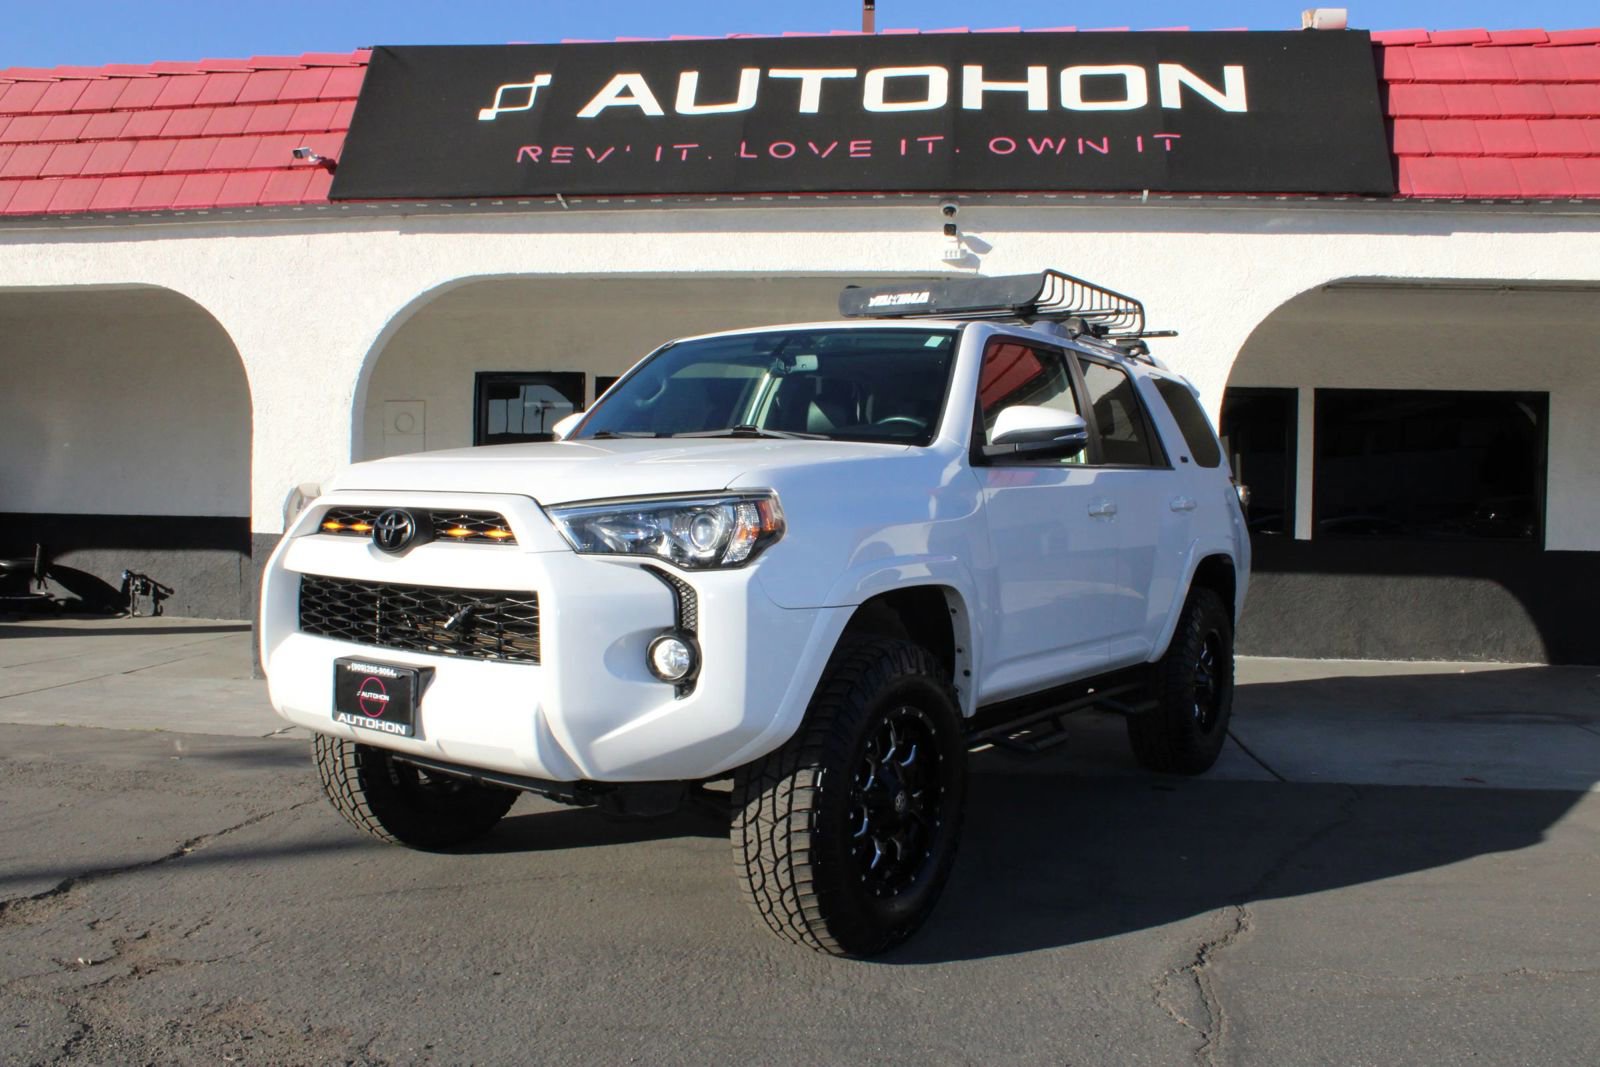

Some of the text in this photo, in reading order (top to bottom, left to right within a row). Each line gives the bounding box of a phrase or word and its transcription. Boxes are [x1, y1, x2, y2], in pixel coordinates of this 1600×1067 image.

[576, 62, 1249, 119] AUTOHON
[740, 140, 873, 160] LOVE
[988, 136, 1110, 156] OWN
[1136, 133, 1182, 153] IT
[361, 691, 390, 701] AUTOHON
[338, 713, 406, 735] AUTOHON
